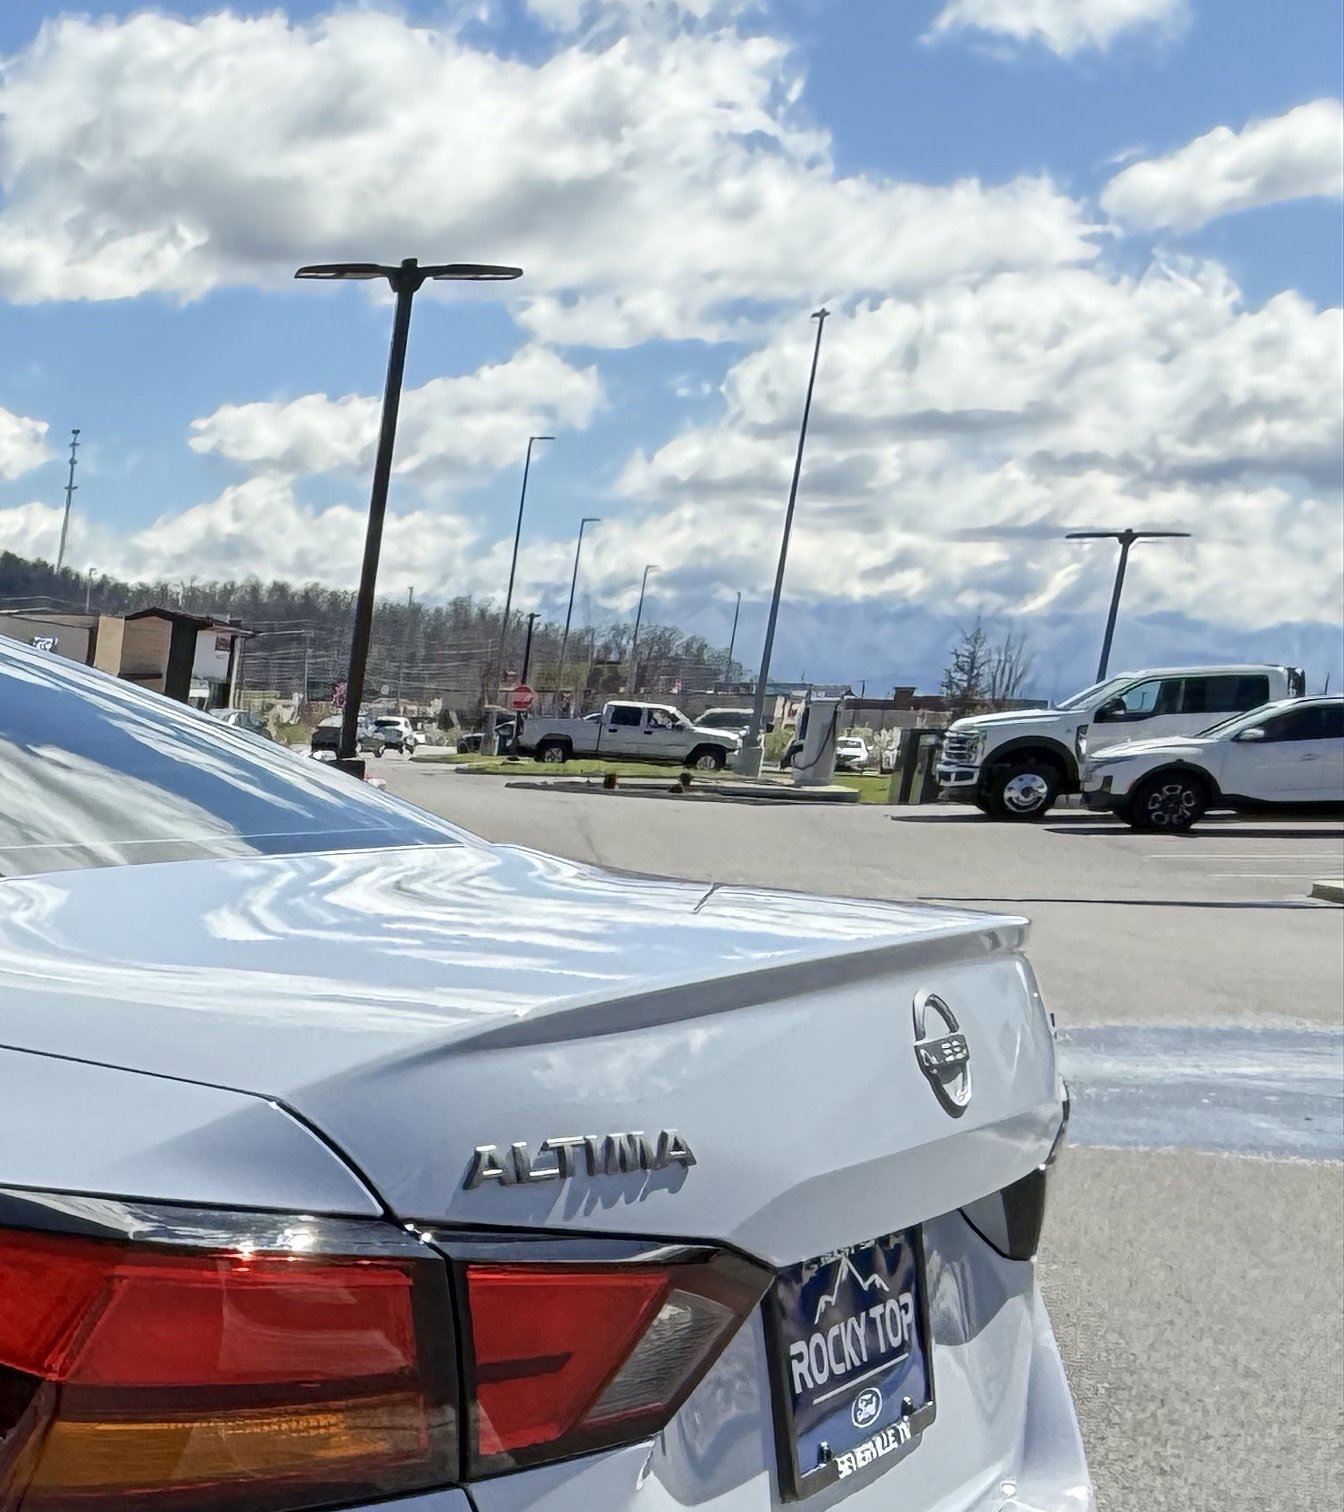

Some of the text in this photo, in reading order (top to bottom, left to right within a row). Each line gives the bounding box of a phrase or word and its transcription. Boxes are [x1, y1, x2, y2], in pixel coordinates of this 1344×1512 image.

[462, 1128, 697, 1191] ALTIMA
[789, 1292, 914, 1395] ROCKY TOP
